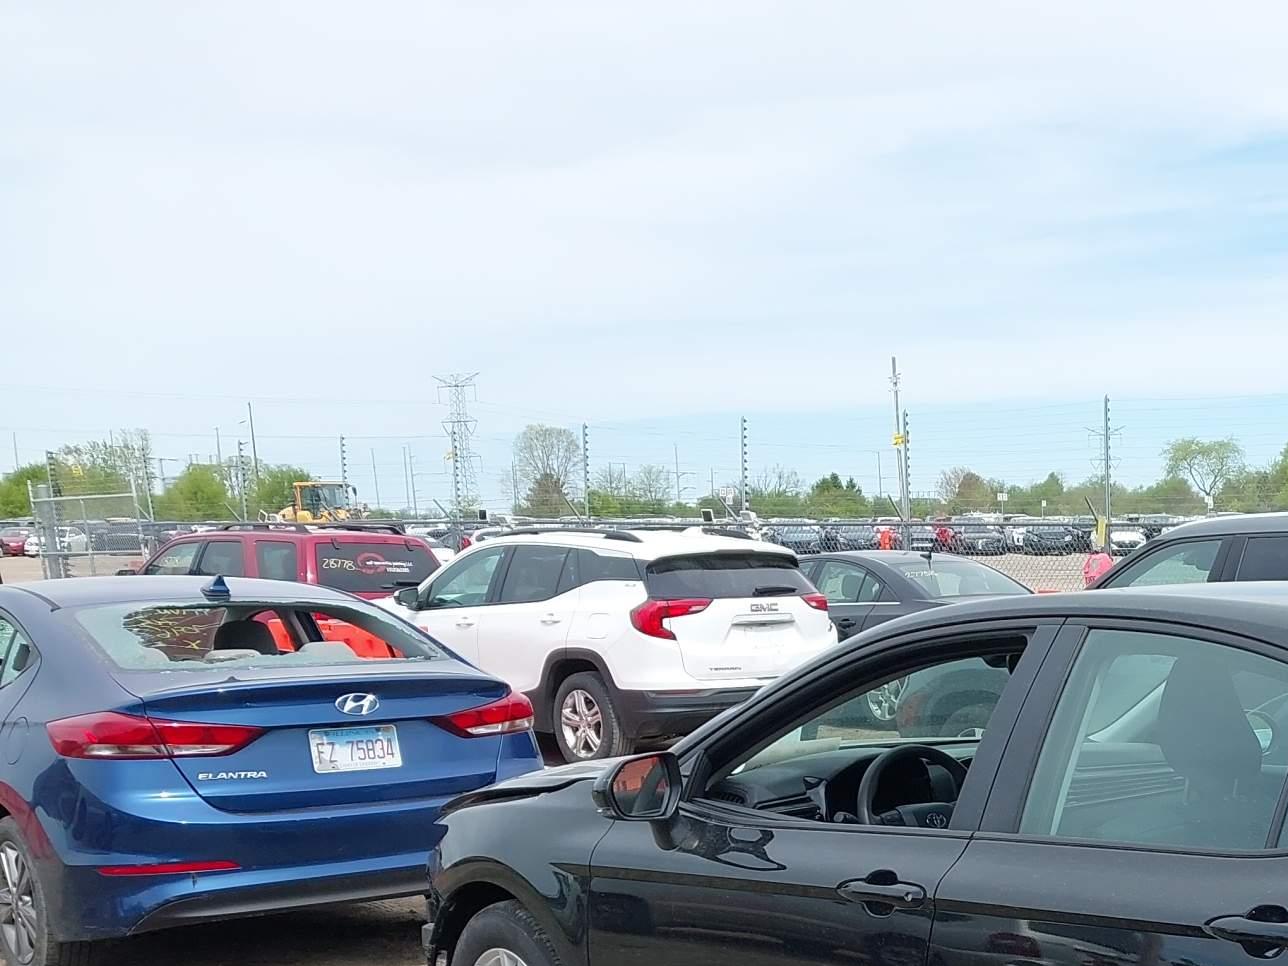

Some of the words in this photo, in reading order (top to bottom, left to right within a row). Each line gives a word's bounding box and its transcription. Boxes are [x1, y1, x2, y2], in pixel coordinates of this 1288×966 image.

[750, 603, 779, 612] GMC
[346, 738, 395, 762] 75834
[198, 771, 268, 781] ELANTRA
